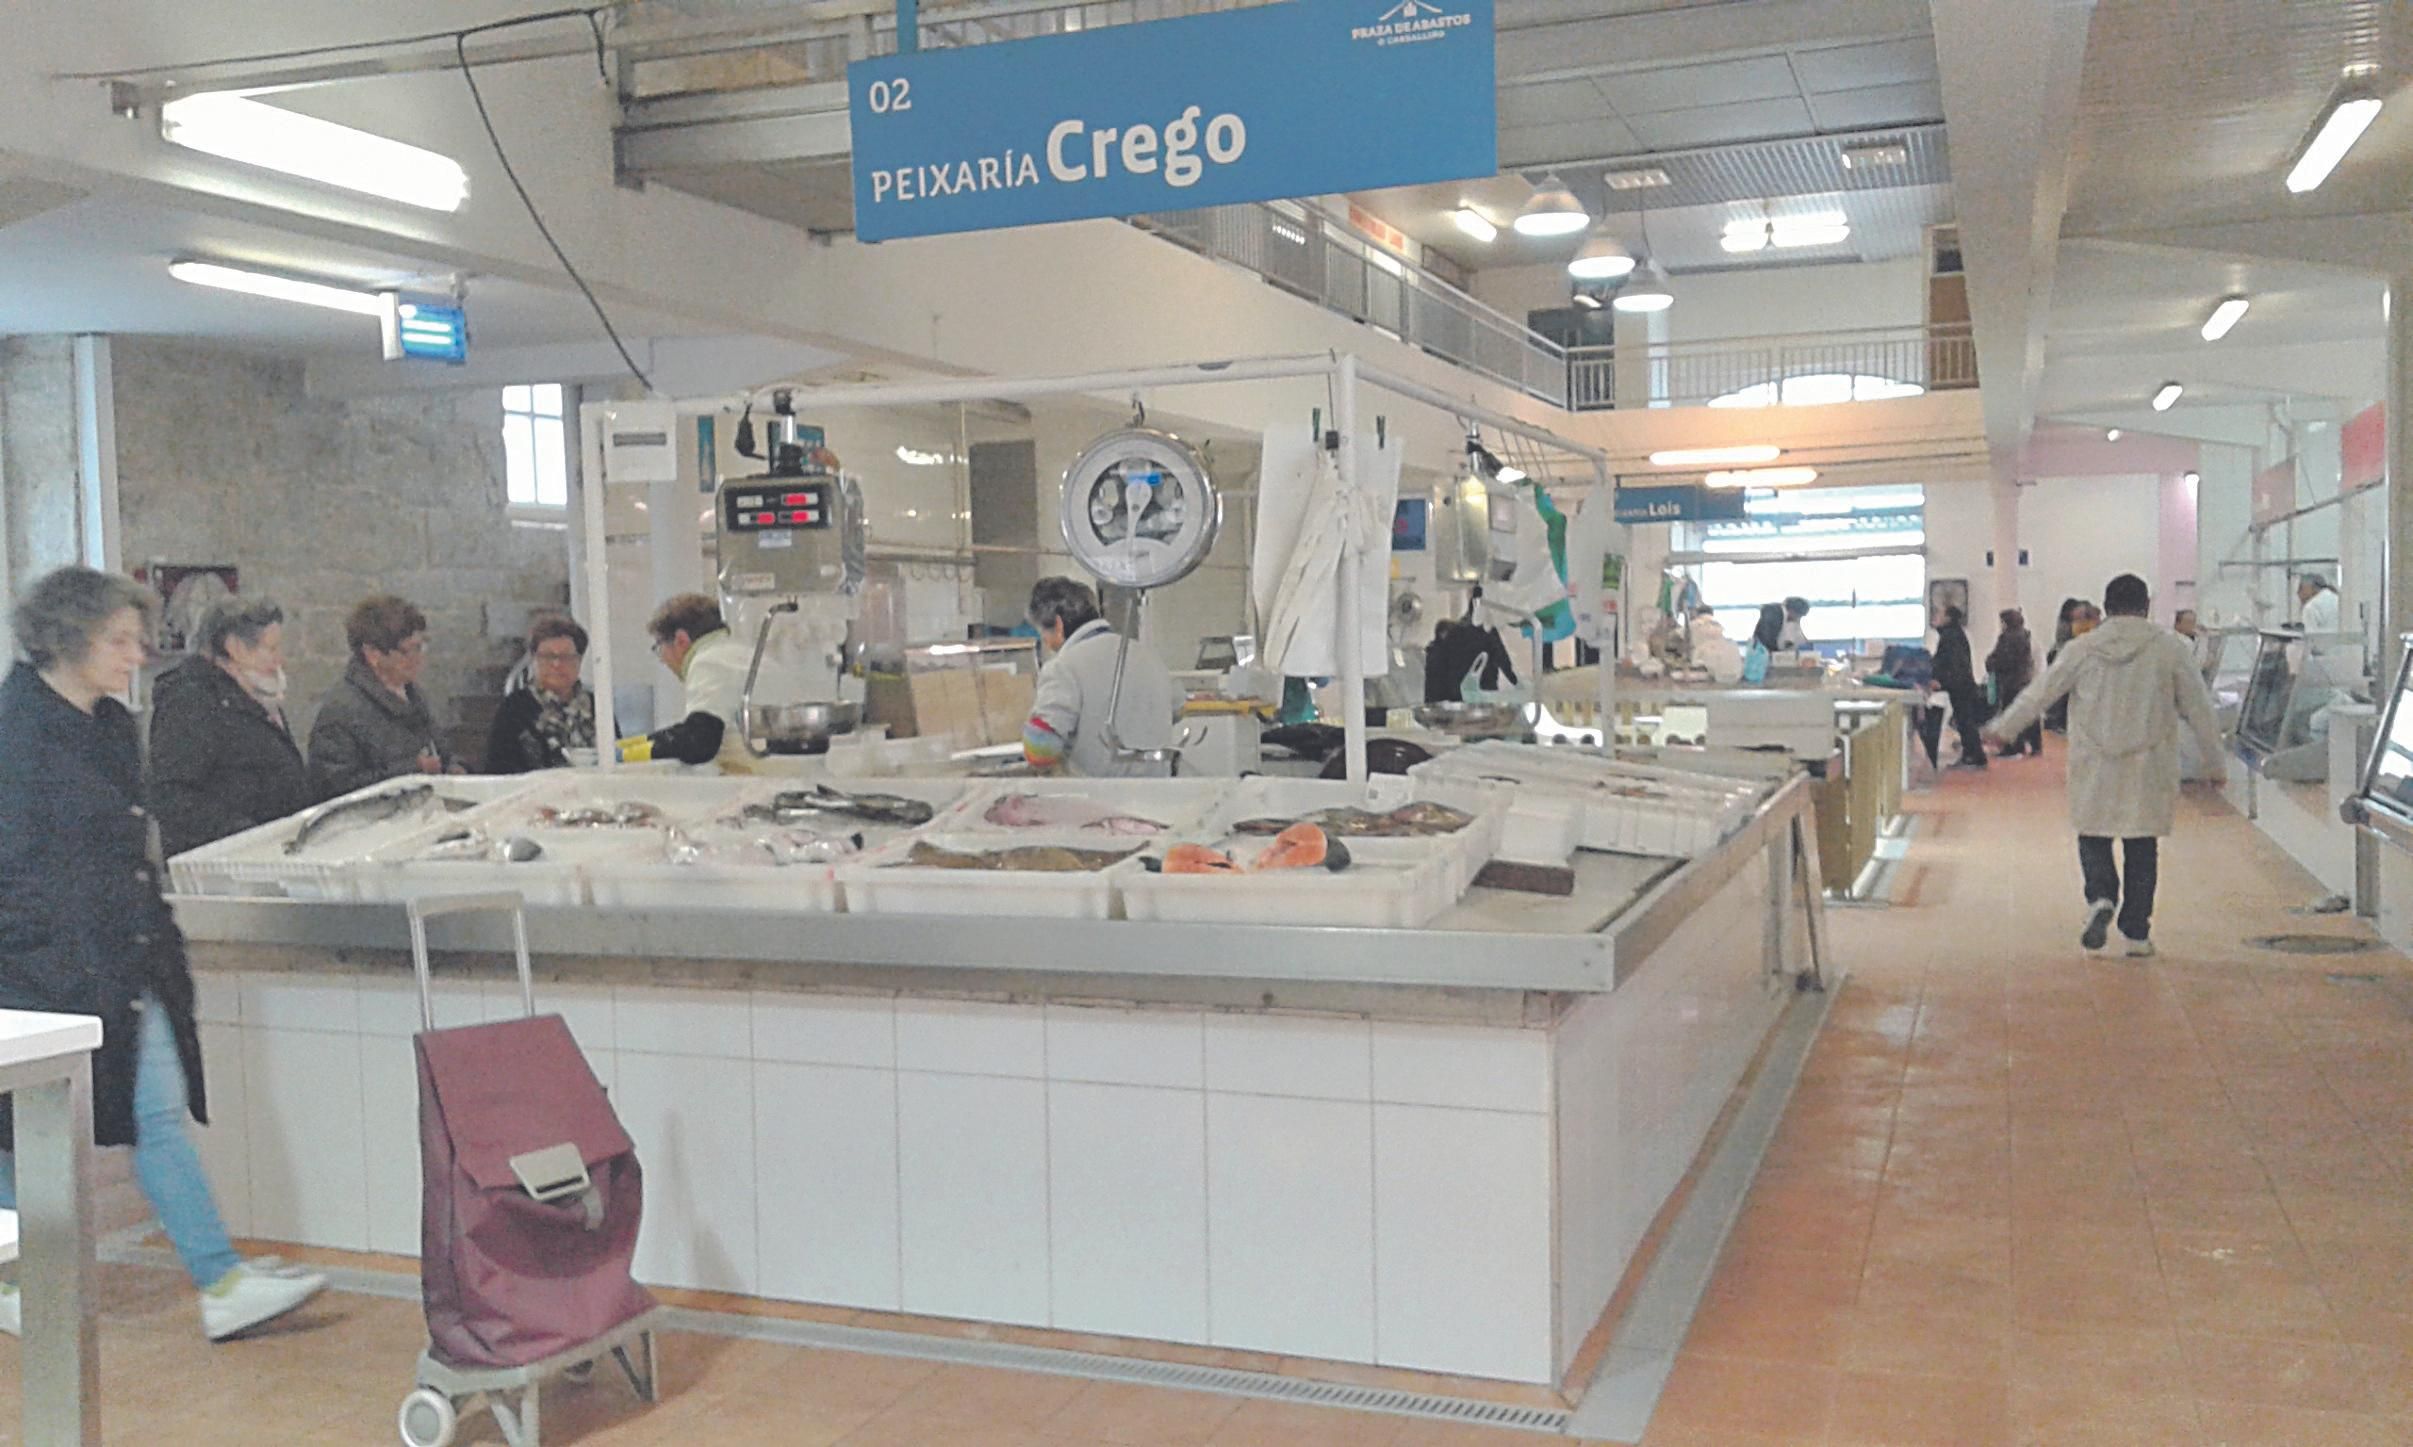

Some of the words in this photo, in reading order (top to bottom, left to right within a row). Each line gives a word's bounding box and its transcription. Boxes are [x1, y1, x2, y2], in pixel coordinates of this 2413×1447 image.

[870, 79, 911, 113] 02
[872, 150, 1039, 202] PEIXARÍA
[1047, 106, 1246, 187] Crego
[1649, 500, 1680, 516] Lois
